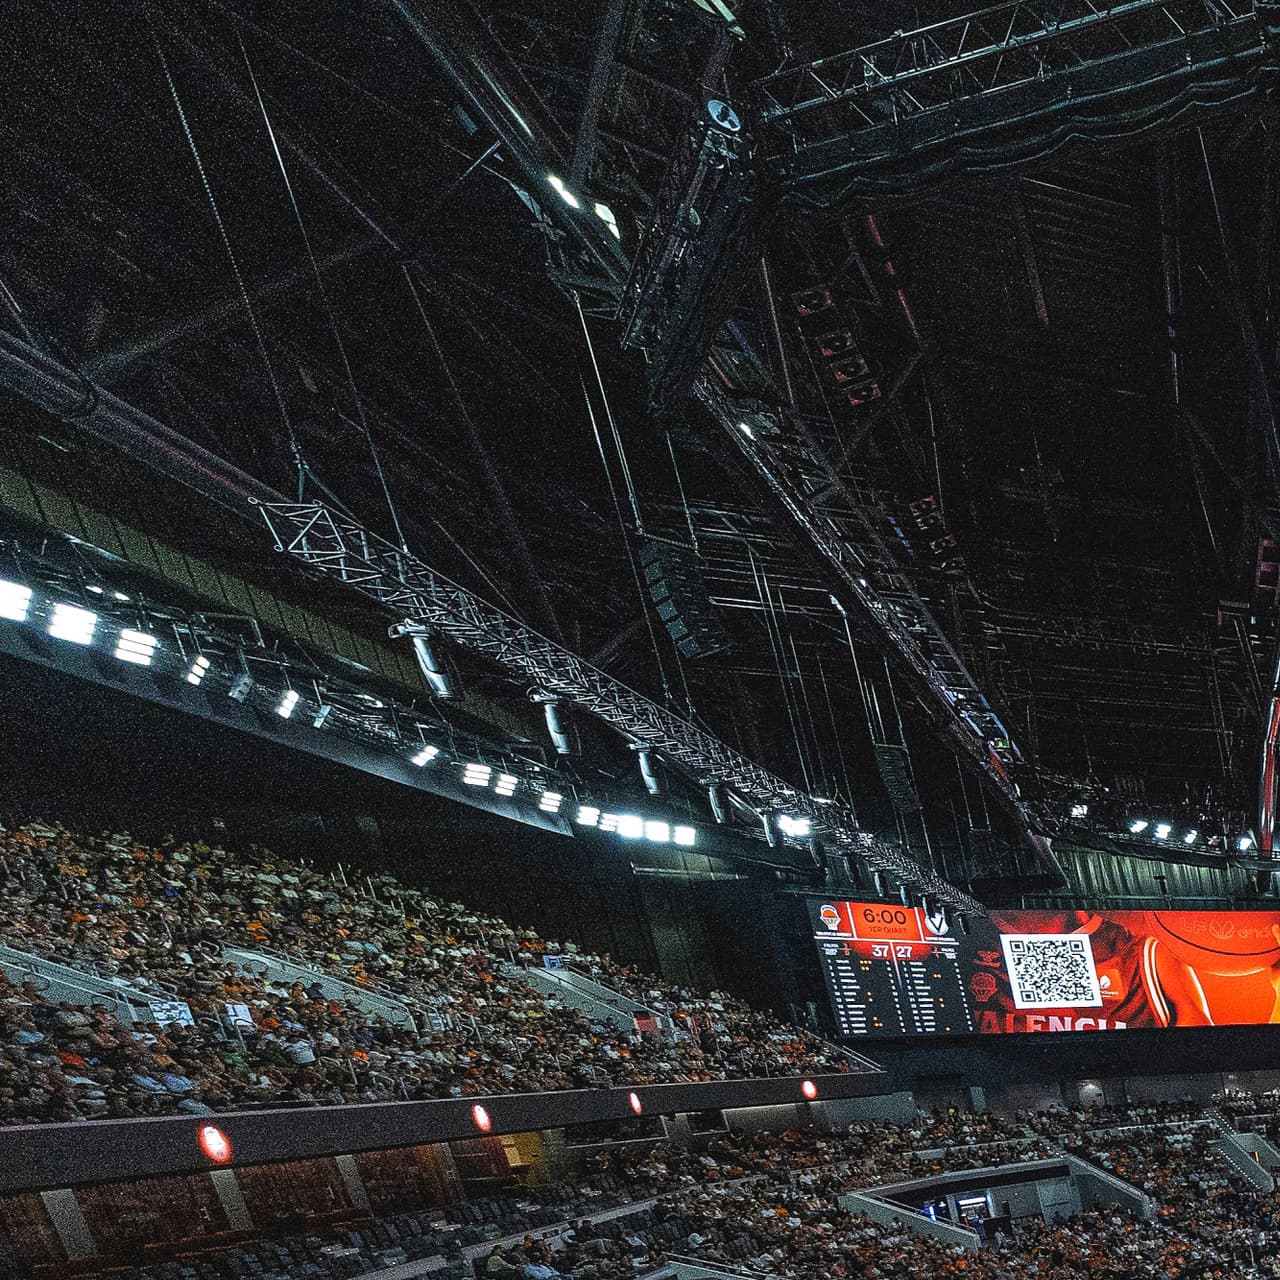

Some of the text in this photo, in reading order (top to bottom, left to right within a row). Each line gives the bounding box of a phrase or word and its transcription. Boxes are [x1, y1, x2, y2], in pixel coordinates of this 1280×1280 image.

[863, 908, 907, 925] 6:00
[871, 944, 889, 957] 37
[896, 945, 913, 958] 27
